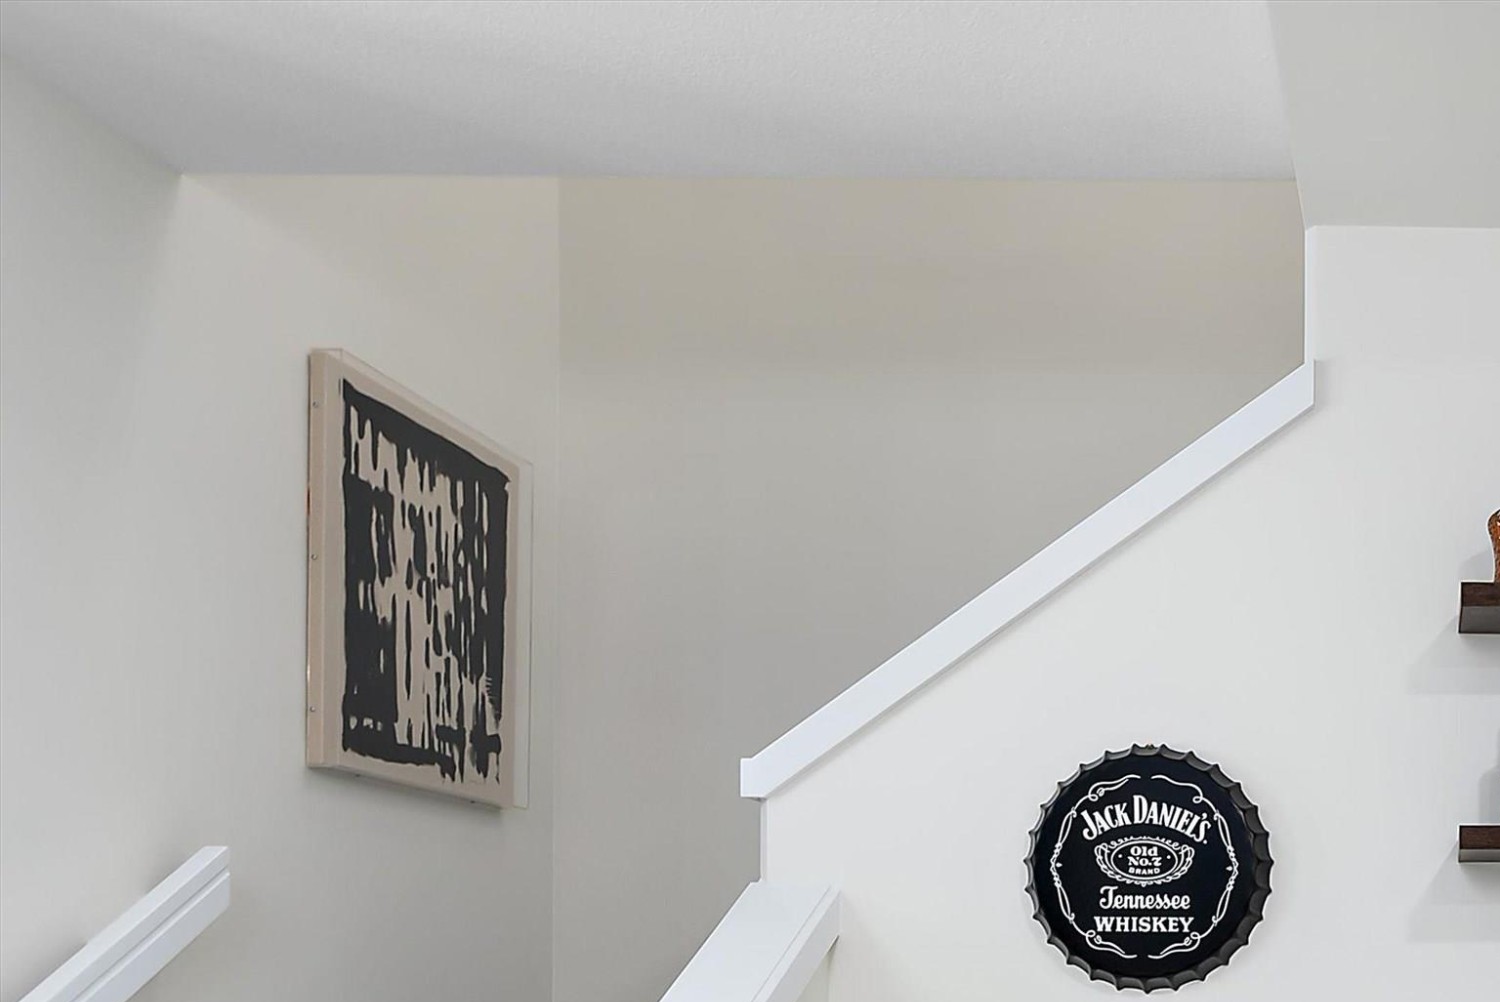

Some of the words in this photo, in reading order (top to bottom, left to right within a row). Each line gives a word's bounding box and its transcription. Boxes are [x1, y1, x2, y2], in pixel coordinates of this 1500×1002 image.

[1080, 802, 1133, 841] JACK
[1130, 846, 1159, 857] Old
[1128, 867, 1161, 875] BRAND
[1099, 885, 1191, 910] Tennessee
[1093, 915, 1195, 933] WHISKEY
